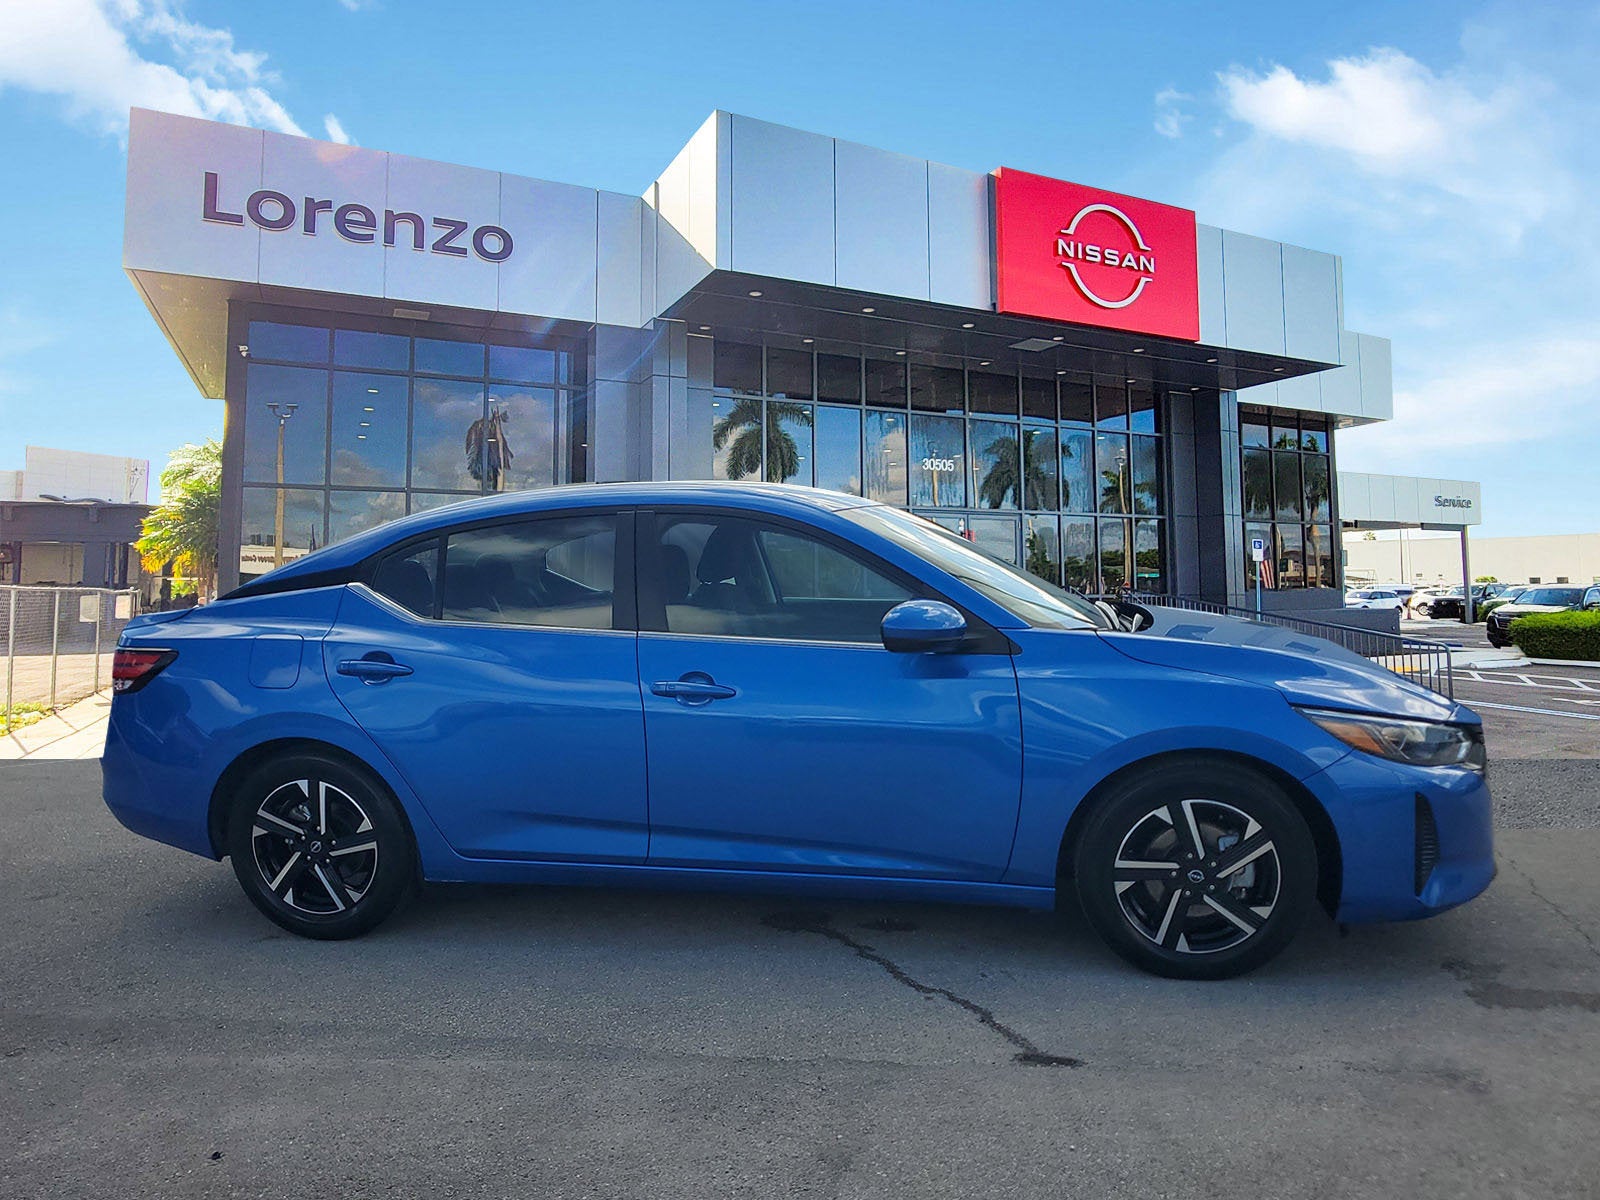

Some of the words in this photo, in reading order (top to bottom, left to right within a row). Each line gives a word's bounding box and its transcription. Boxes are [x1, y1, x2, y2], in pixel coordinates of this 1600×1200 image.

[203, 171, 514, 262] Lorenzo
[1057, 238, 1155, 273] NISSAN
[922, 457, 955, 471] 30505
[1434, 495, 1472, 509] Service
